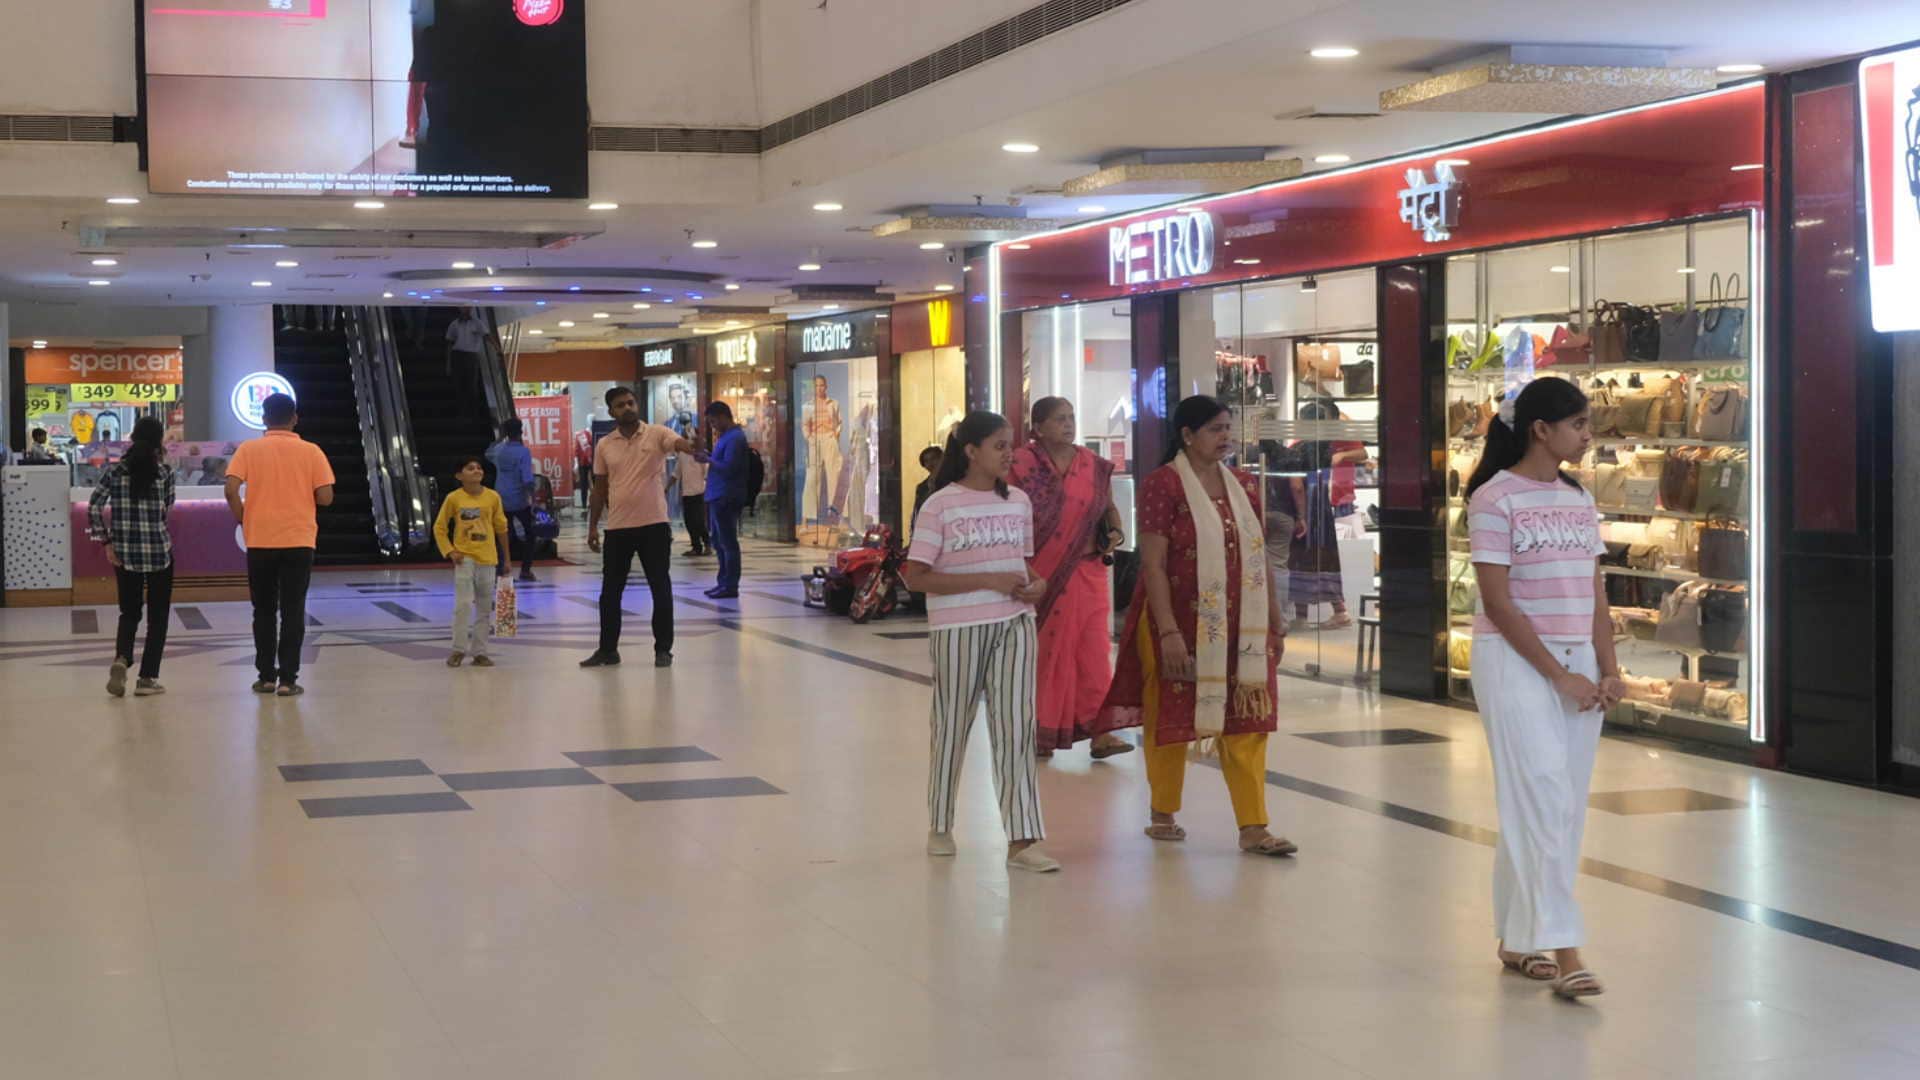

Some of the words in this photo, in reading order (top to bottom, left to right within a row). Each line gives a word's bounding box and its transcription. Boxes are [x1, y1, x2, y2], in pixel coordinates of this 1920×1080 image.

[1109, 211, 1214, 286] METRO
[803, 322, 851, 352] madame
[927, 299, 951, 346] W
[521, 418, 561, 445] ALE
